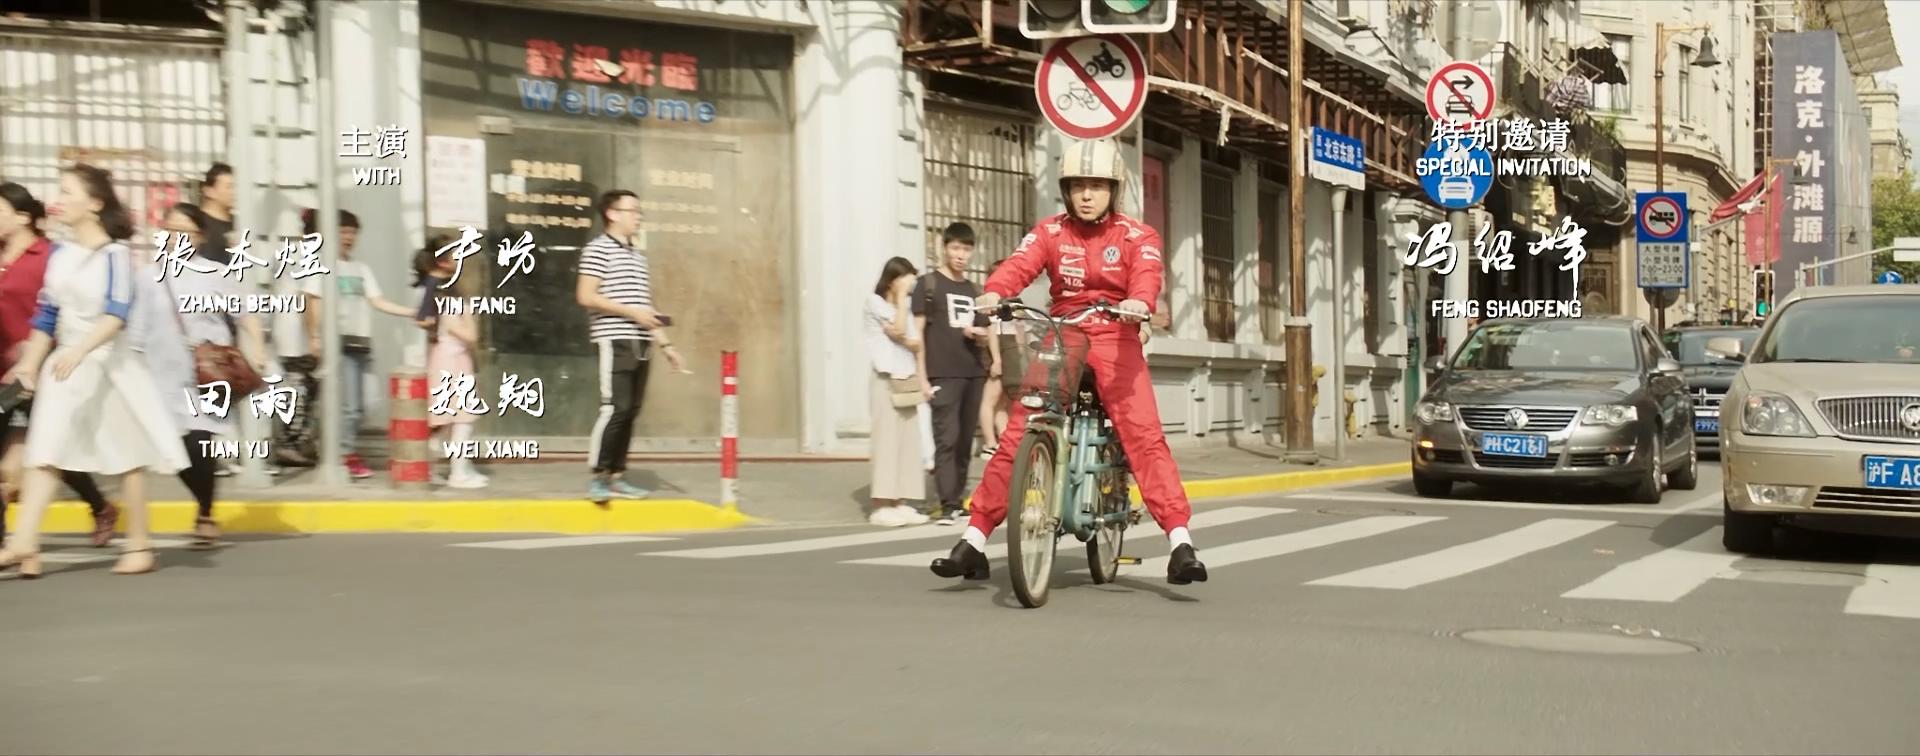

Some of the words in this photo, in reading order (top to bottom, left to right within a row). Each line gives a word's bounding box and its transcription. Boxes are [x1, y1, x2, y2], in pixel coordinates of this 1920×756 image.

[517, 78, 717, 123] Welcome
[1793, 65, 1825, 243] 洛克·外滩源
